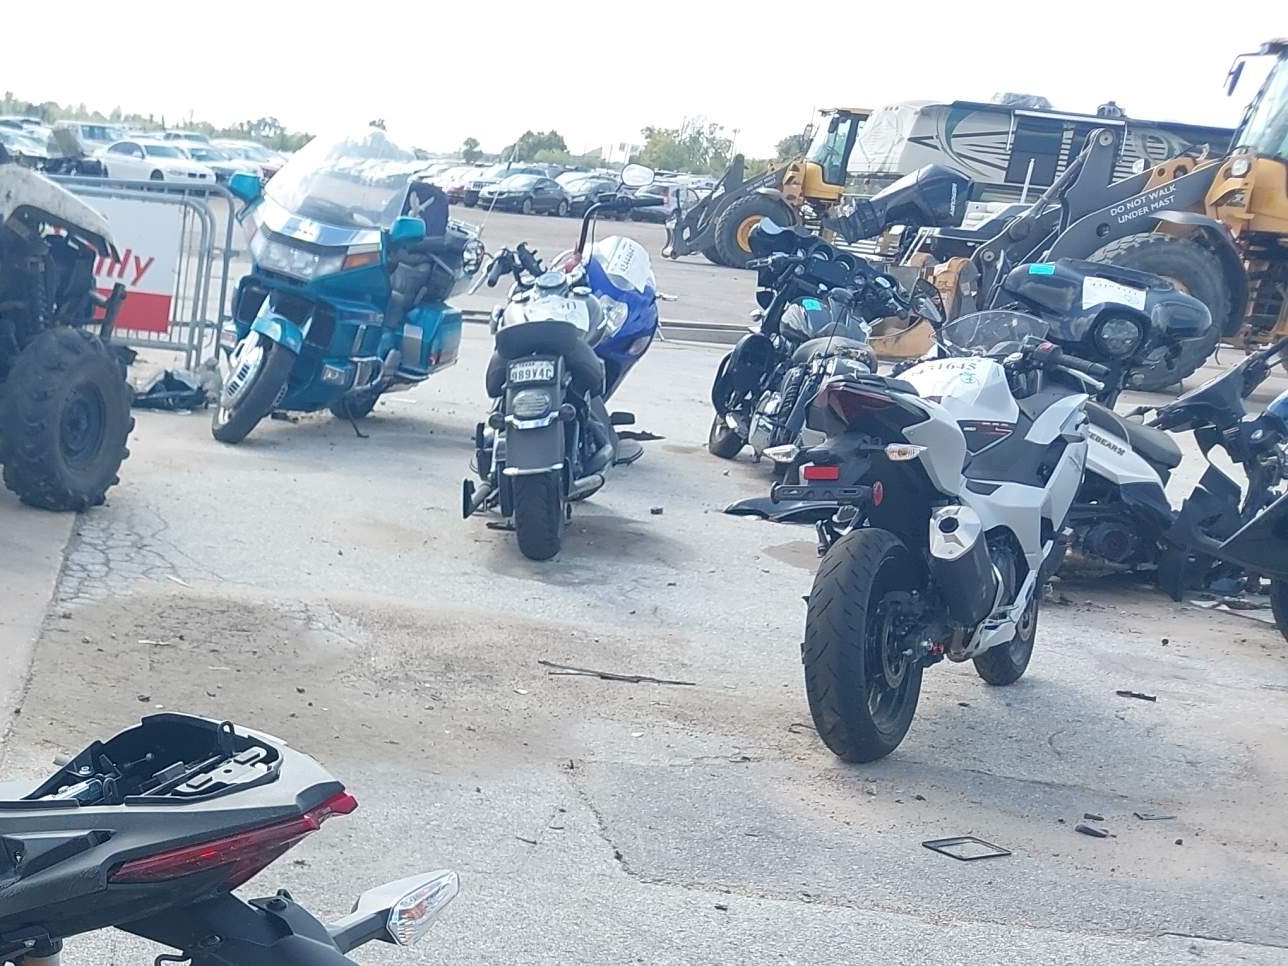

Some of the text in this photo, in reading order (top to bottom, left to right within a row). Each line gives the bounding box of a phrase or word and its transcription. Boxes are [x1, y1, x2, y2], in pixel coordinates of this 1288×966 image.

[1110, 184, 1177, 216] DO NOT WALK
[1117, 195, 1176, 223] UNDER MAST
